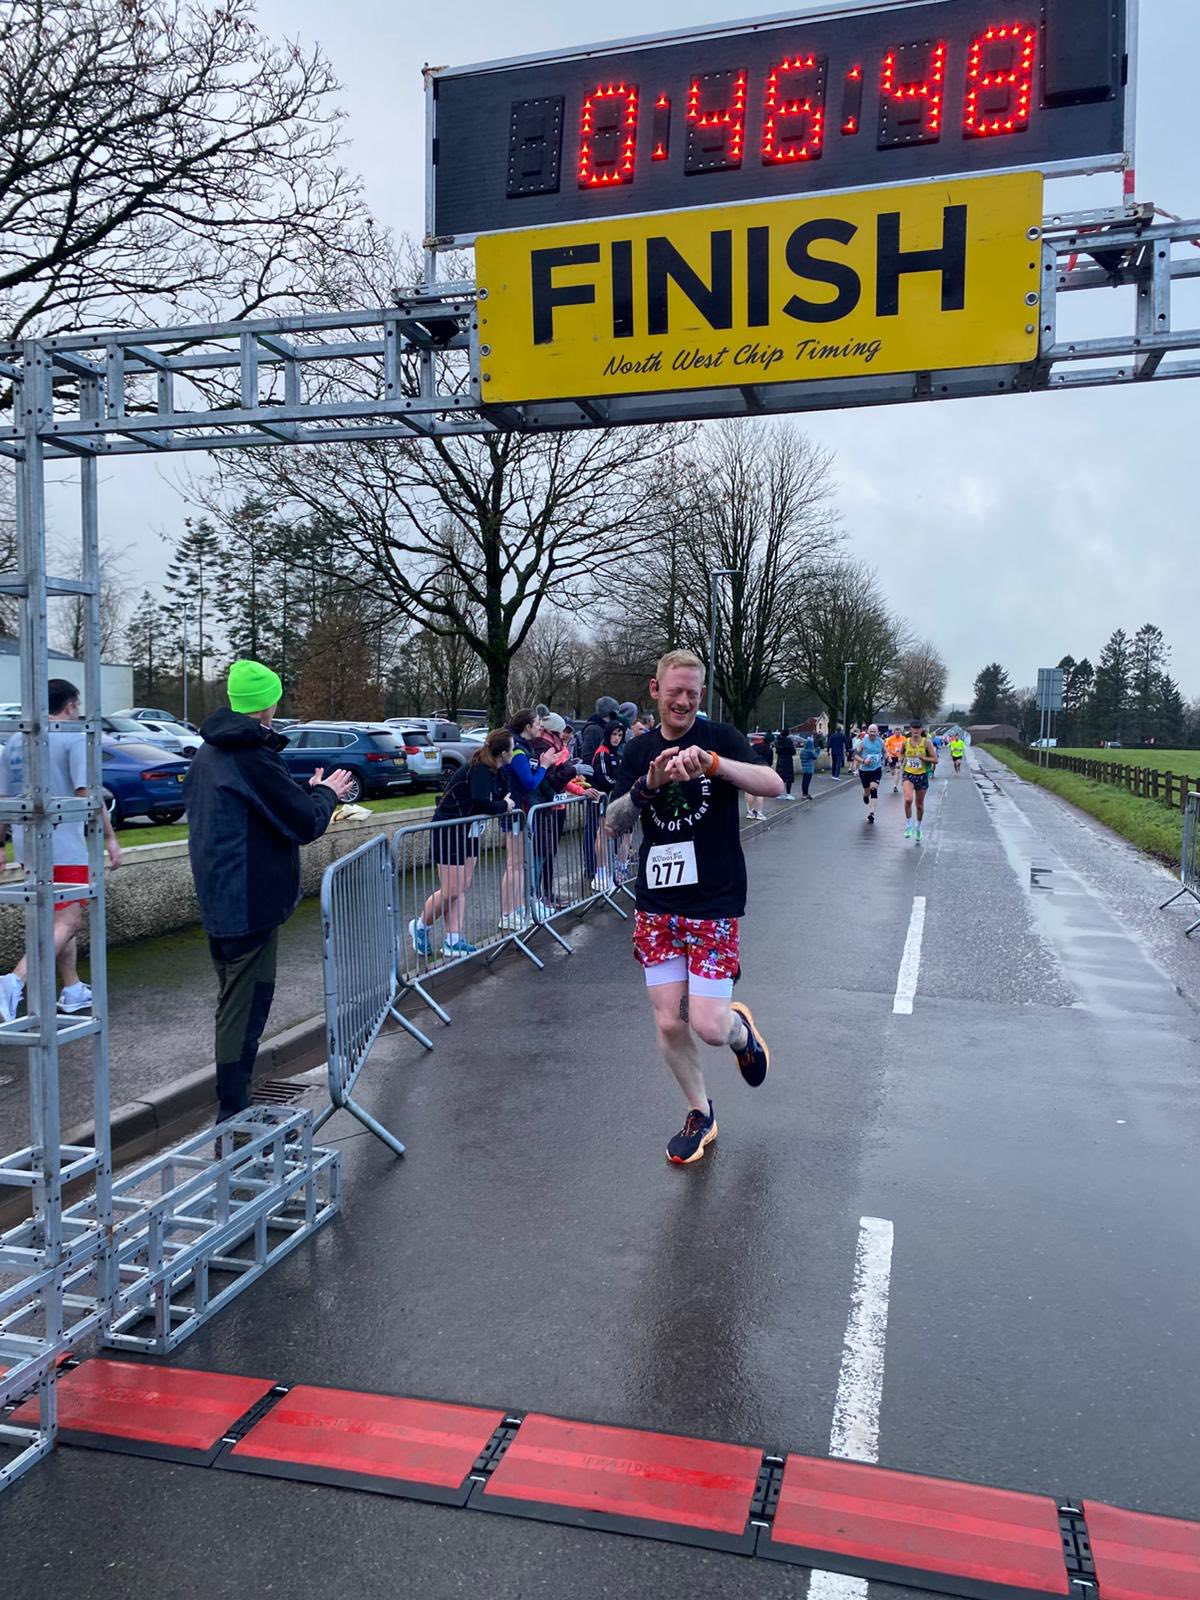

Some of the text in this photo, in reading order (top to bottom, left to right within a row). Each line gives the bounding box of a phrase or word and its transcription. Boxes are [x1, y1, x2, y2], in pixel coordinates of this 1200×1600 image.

[579, 23, 1036, 187] 0:46:48
[531, 204, 967, 346] FINISH
[603, 338, 882, 376] North West Chip Timing
[652, 860, 685, 886] 277
